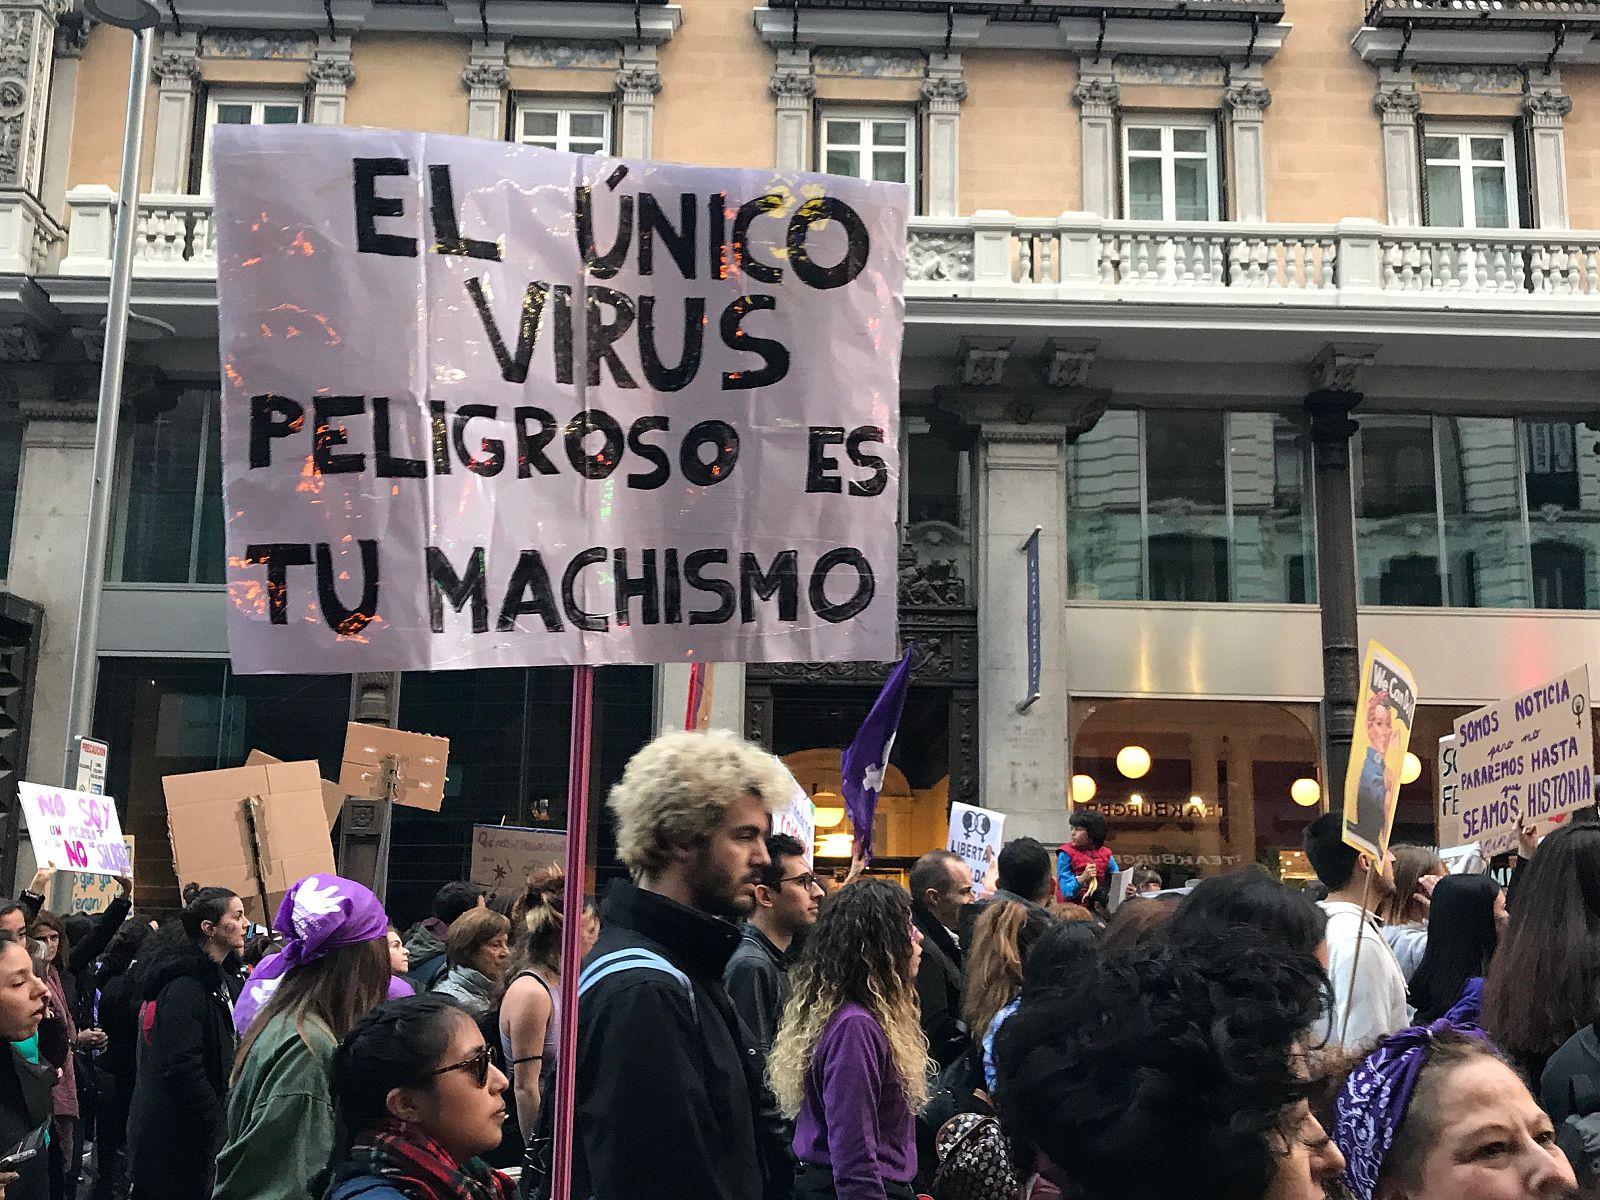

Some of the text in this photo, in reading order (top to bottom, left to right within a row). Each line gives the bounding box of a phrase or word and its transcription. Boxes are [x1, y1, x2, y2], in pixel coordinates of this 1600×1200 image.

[352, 157, 870, 290] EL ÚNICO
[464, 276, 791, 391] VIRUS
[249, 395, 889, 497] PELIGROSO ES
[246, 539, 875, 636] TU MACHISMO
[1373, 663, 1388, 691] We
[1460, 679, 1570, 747] SOMOS NOTICIA
[1461, 736, 1578, 790] PARAREMOS HASTA
[1487, 729, 1541, 761] pero no
[37, 794, 110, 831] NO SOY
[1463, 765, 1591, 839] SEAMOS HISTORIA
[1501, 783, 1522, 798] que
[64, 840, 88, 868] NO
